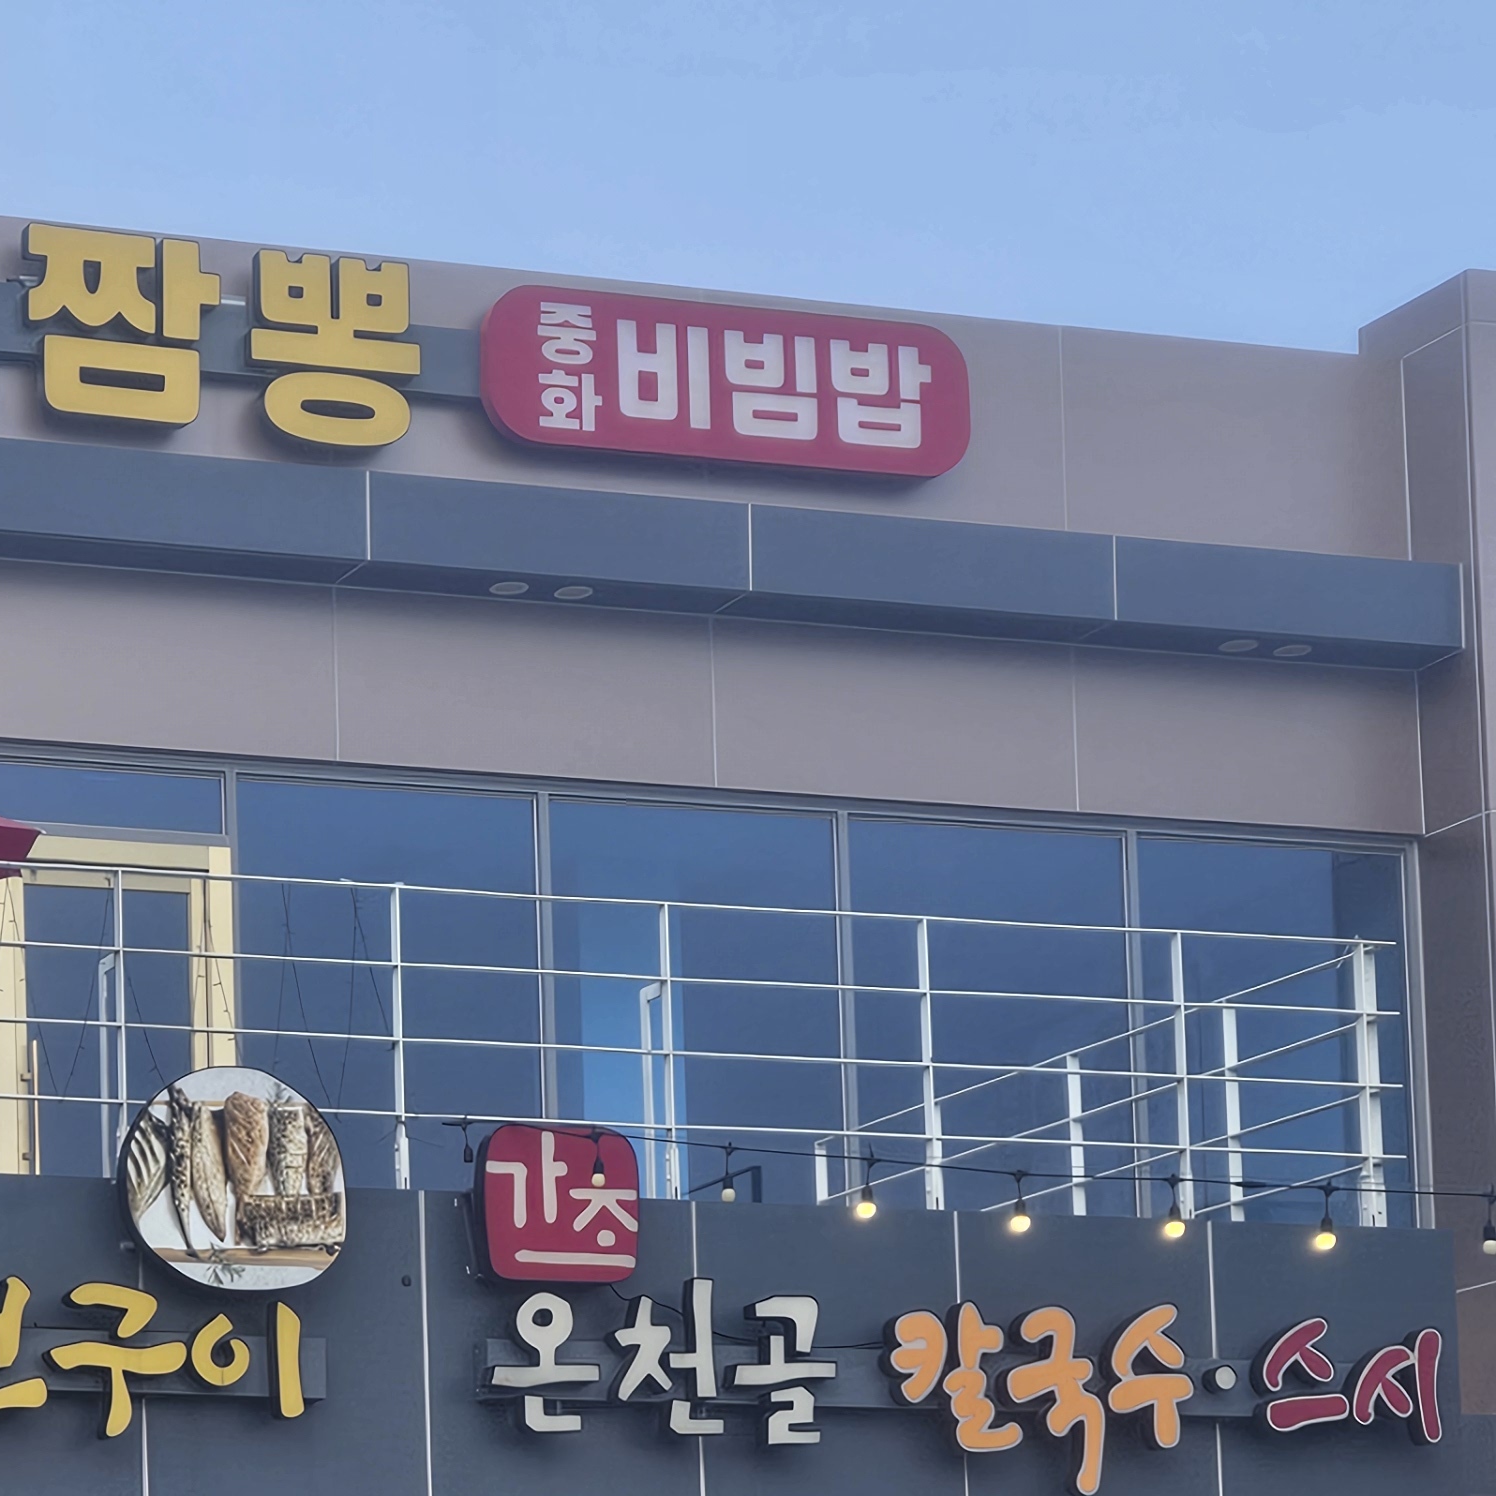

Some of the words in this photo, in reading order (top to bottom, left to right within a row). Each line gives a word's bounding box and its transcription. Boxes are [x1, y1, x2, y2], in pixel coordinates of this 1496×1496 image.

[616, 318, 932, 449] 비빔밥
[485, 1131, 638, 1268] 가조
[490, 1278, 837, 1445] 온천골
